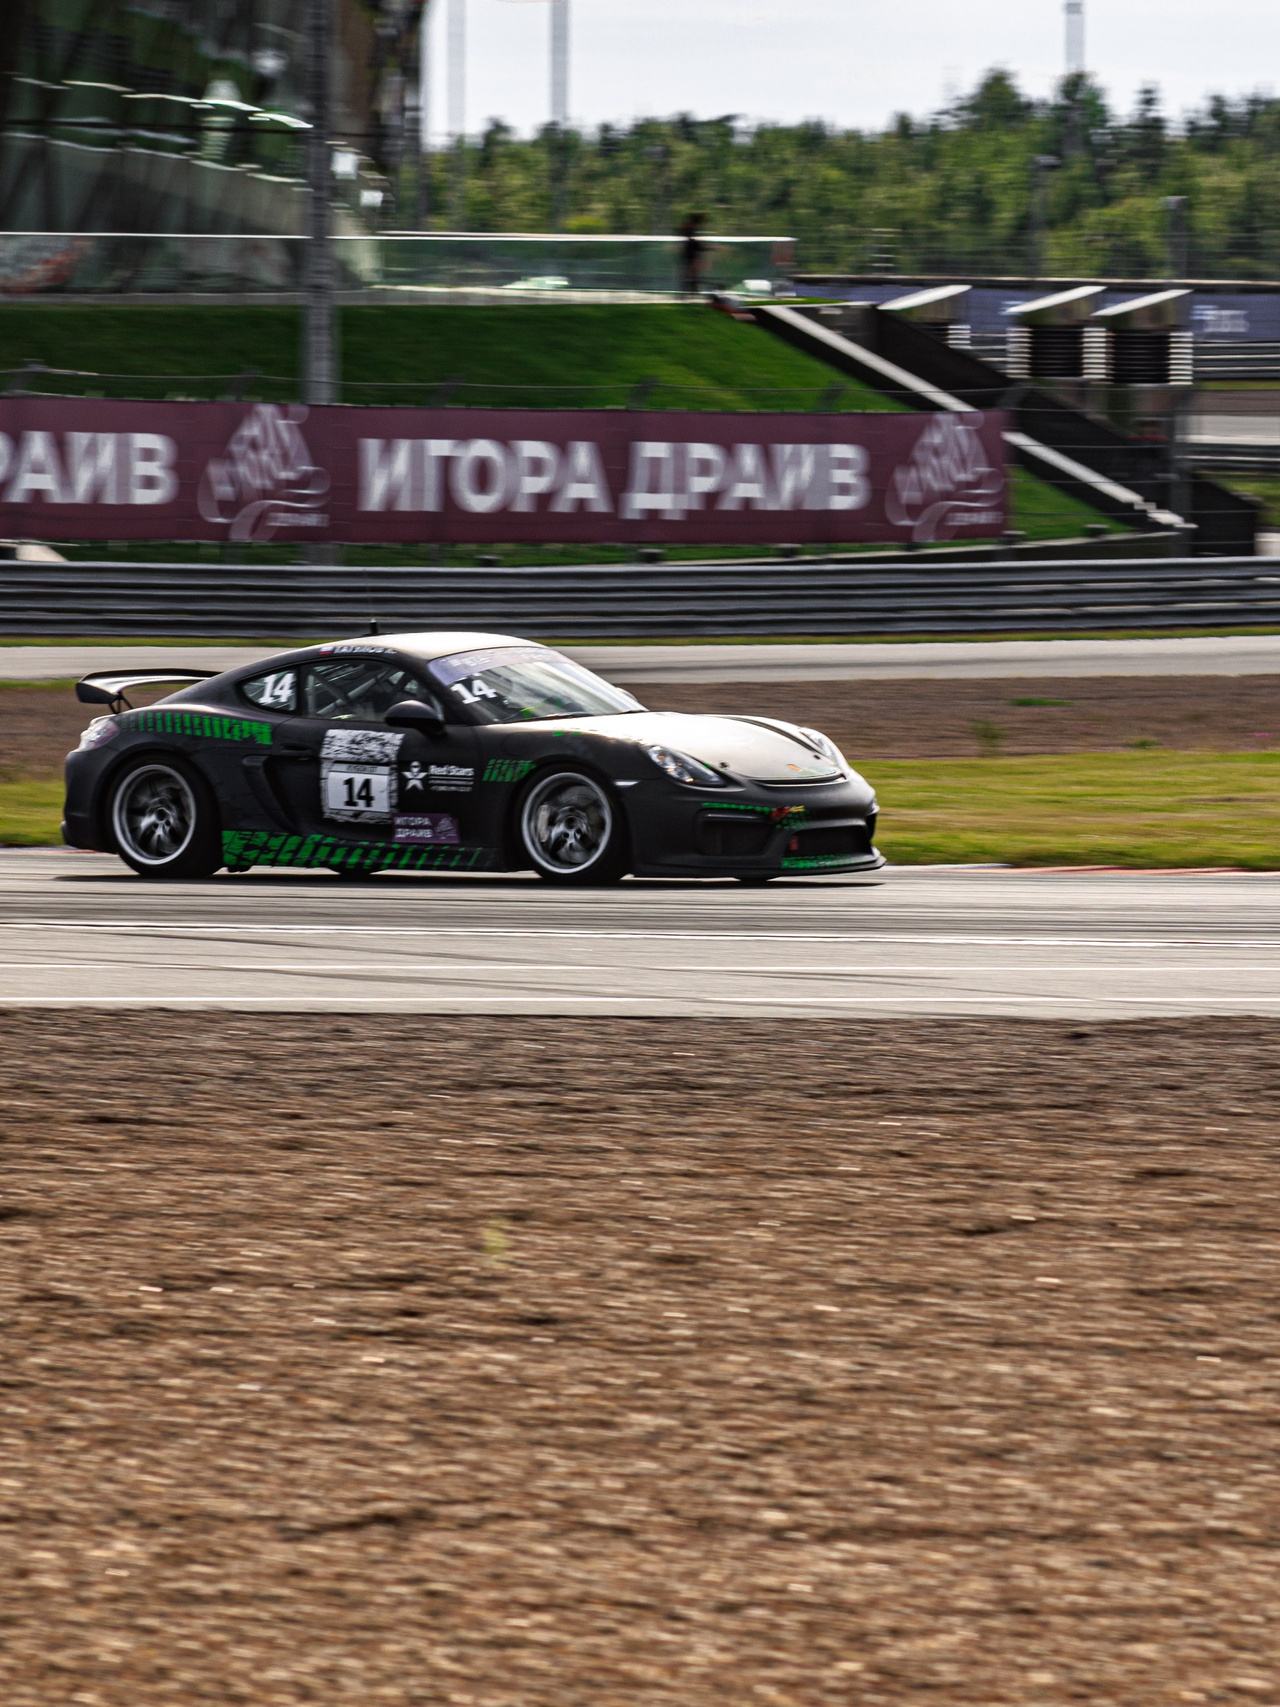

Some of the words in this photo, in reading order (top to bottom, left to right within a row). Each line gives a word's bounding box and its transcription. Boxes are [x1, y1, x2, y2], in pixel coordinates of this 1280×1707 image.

[357, 437, 615, 514] ИГОРА
[618, 441, 872, 521] ДРАЙВ
[258, 673, 295, 704] 14
[450, 679, 498, 705] 14
[343, 777, 376, 808] 14
